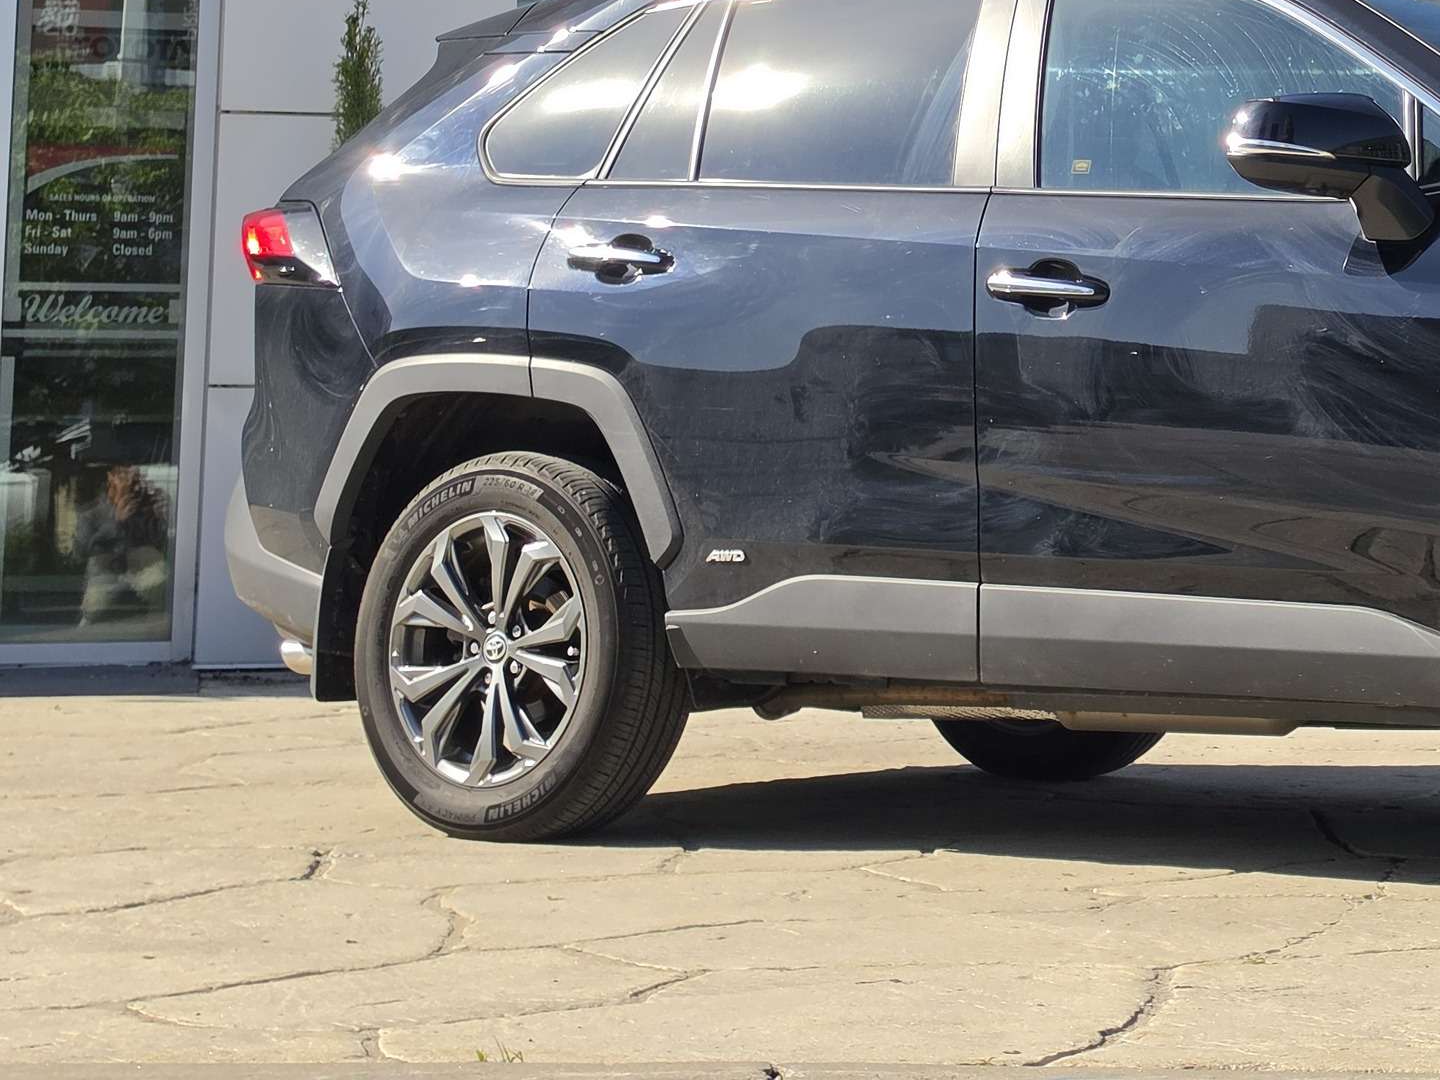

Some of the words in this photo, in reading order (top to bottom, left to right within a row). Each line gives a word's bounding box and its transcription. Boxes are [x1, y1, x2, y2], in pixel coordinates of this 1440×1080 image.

[50, 194, 73, 202] SALES
[25, 209, 53, 221] Mon
[64, 209, 97, 222] Thurs
[113, 211, 138, 223] 9am
[149, 211, 174, 225] 9pm
[25, 225, 41, 238] Fri
[52, 226, 72, 238] Sat
[113, 228, 138, 239] 9am
[24, 242, 69, 257] Sunday
[112, 243, 153, 256] Closed
[24, 294, 167, 324] Welcome
[407, 478, 473, 529] MICHELIN
[705, 549, 746, 563] AWD
[487, 773, 557, 820] MICHELIN
